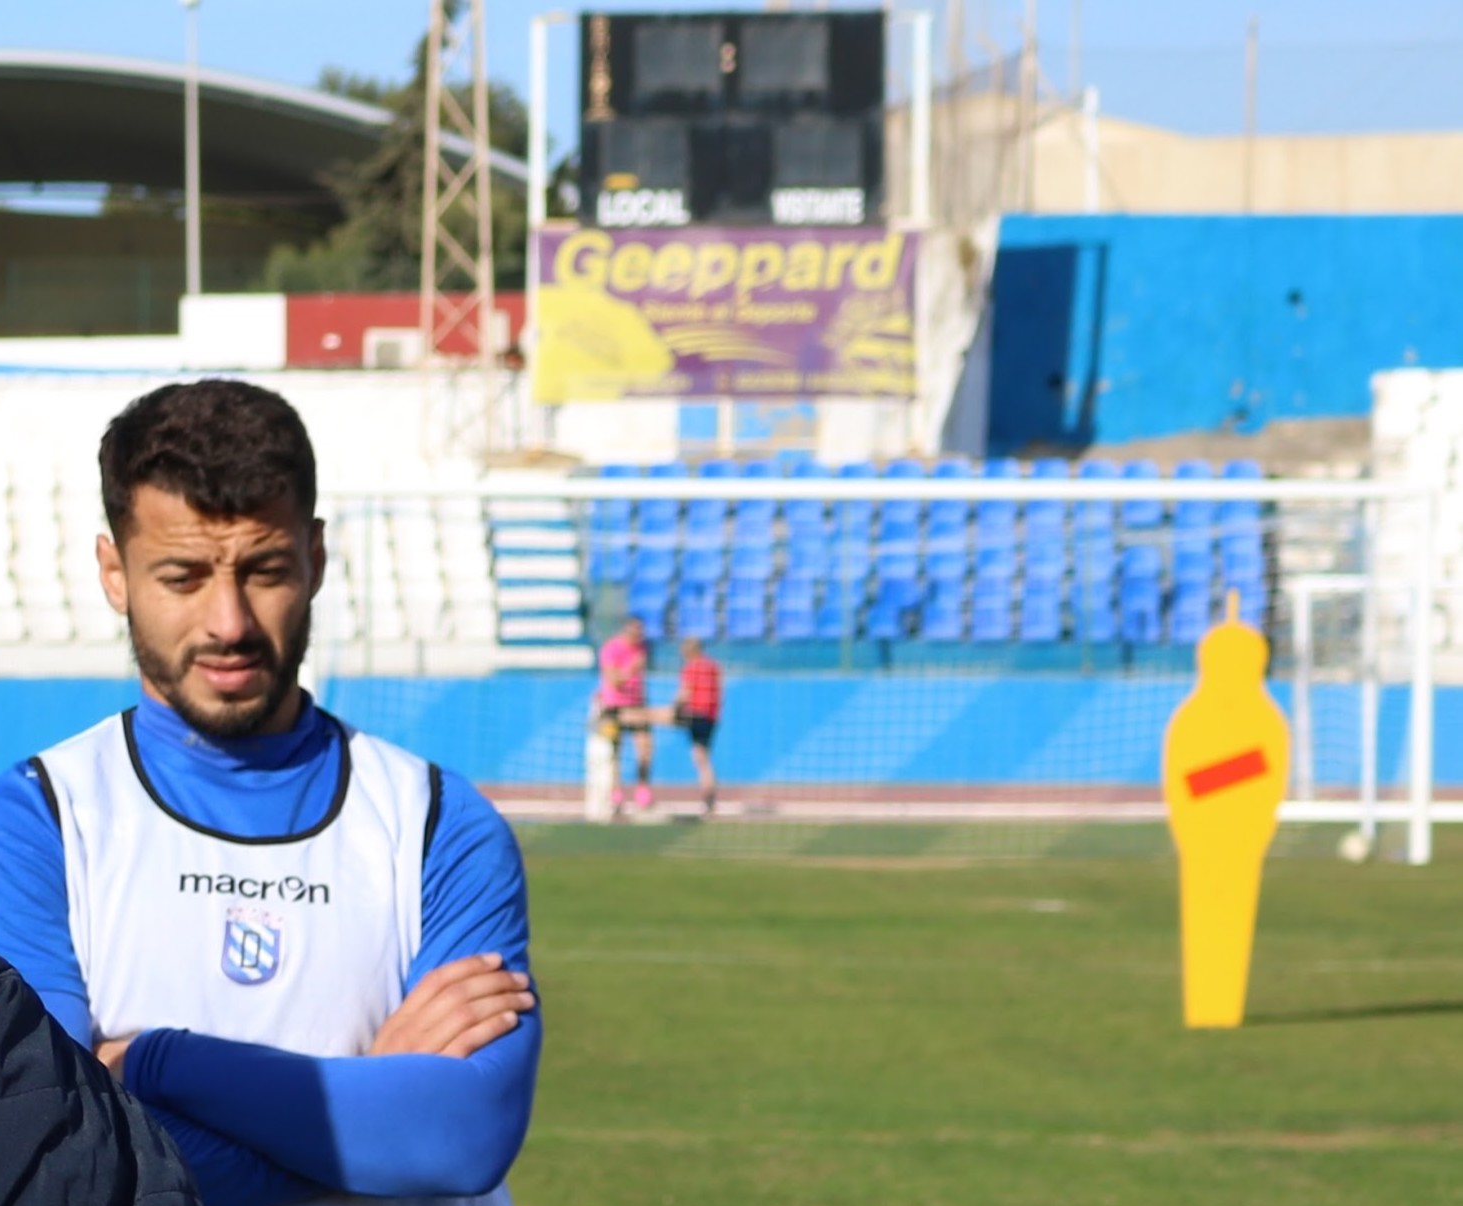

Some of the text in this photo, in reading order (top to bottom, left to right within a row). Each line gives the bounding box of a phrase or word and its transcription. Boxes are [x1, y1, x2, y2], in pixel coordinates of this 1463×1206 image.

[597, 189, 691, 227] LOCAL
[554, 229, 905, 302] Geeppard
[178, 873, 330, 904] macron
